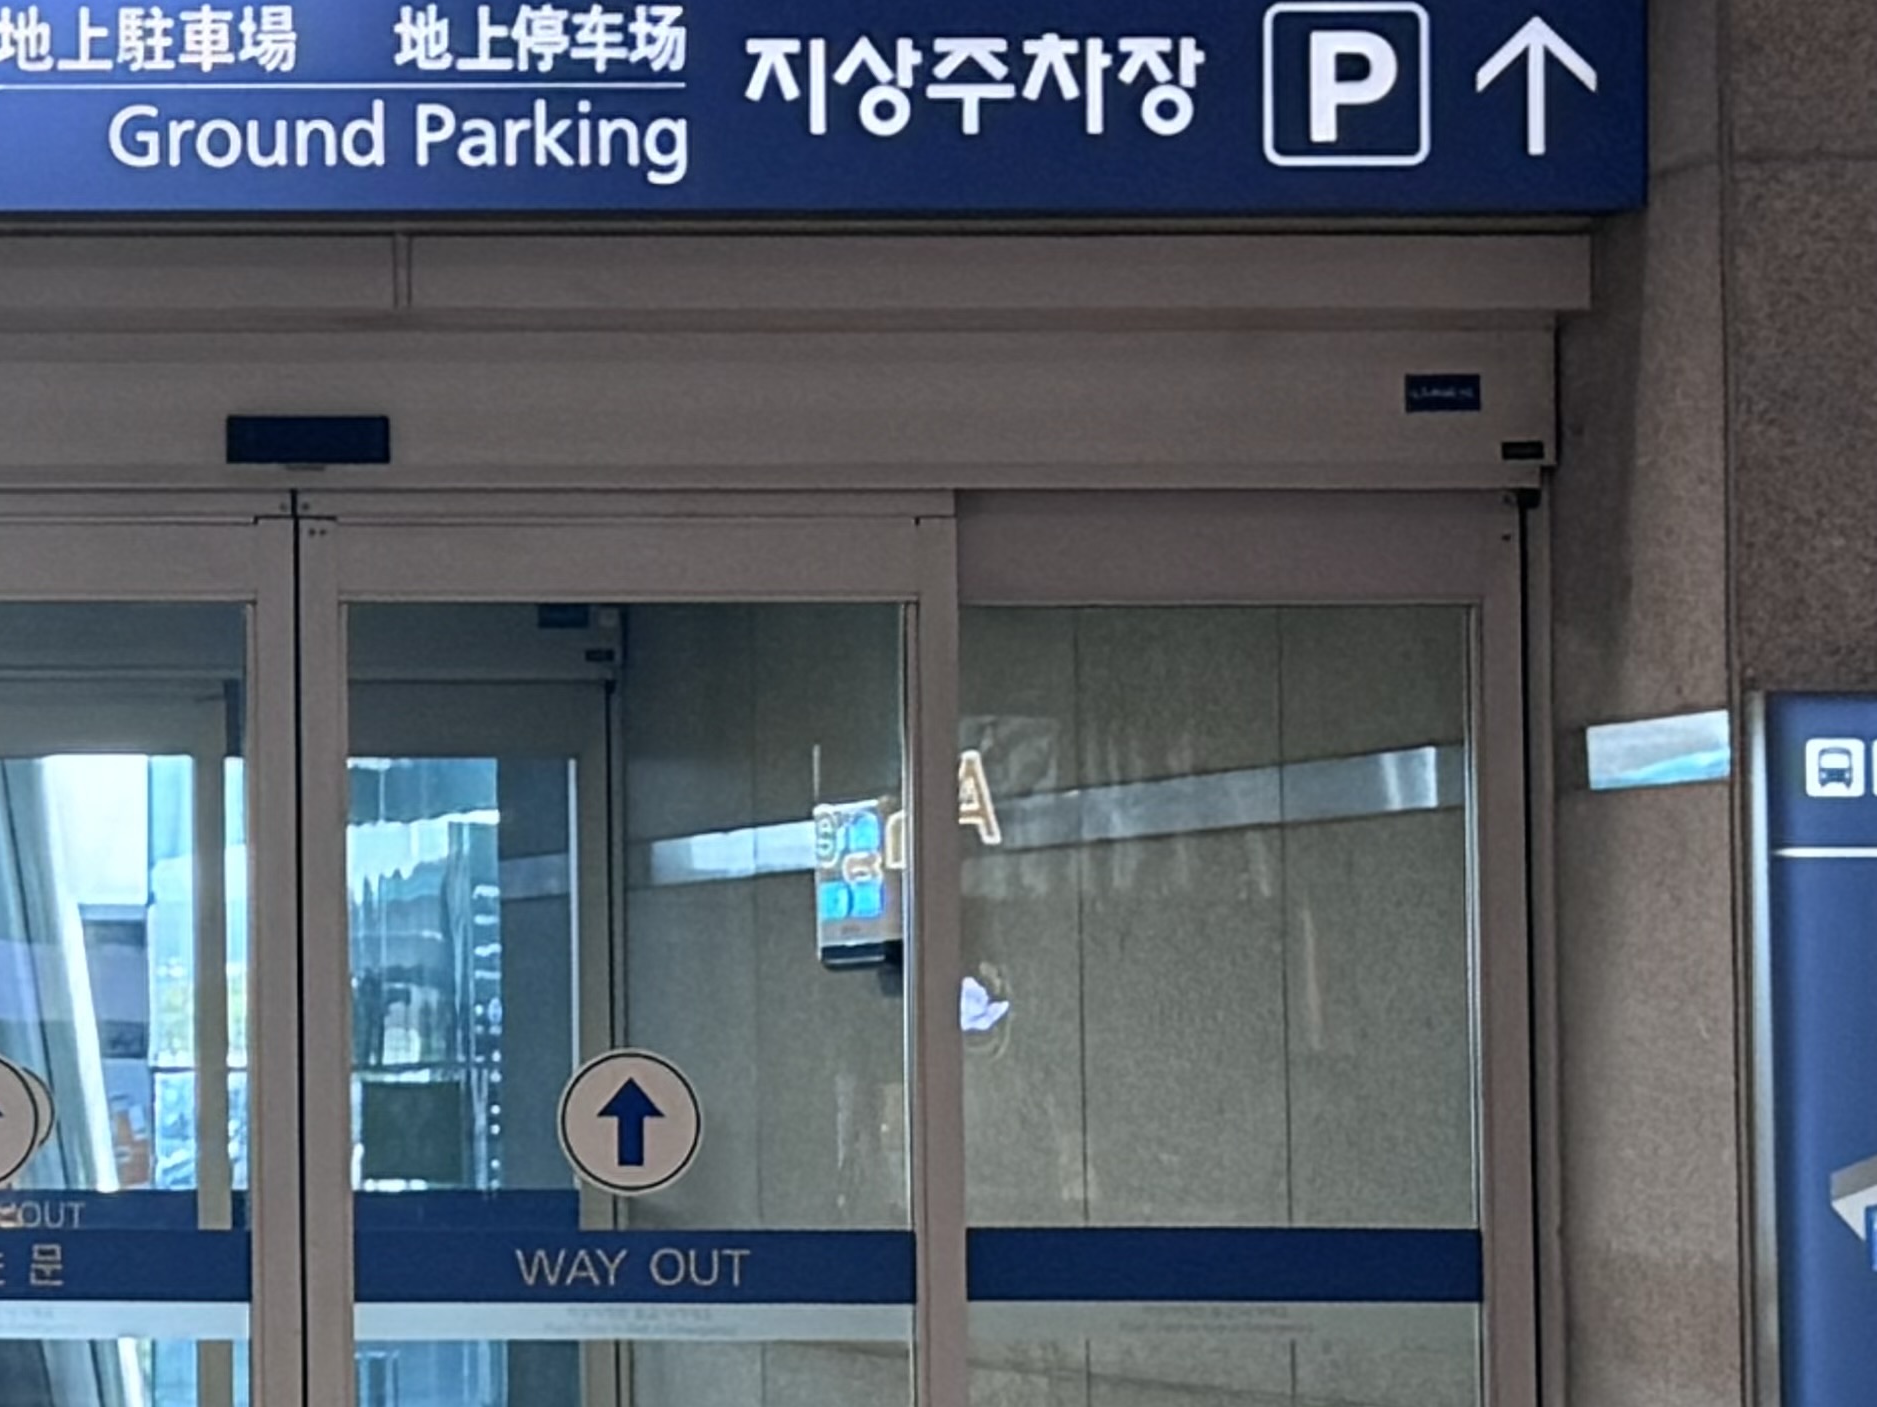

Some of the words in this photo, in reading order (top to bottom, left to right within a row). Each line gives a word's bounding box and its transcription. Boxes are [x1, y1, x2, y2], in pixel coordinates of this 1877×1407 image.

[393, 3, 687, 73] 地上停车场
[745, 33, 1205, 136] 지상주차장
[108, 99, 385, 168] Ground
[416, 98, 688, 185] Parking
[19, 1201, 86, 1229] OUT
[29, 1243, 64, 1286] 문
[515, 1249, 627, 1286] WAY
[649, 1248, 751, 1286] OUT
